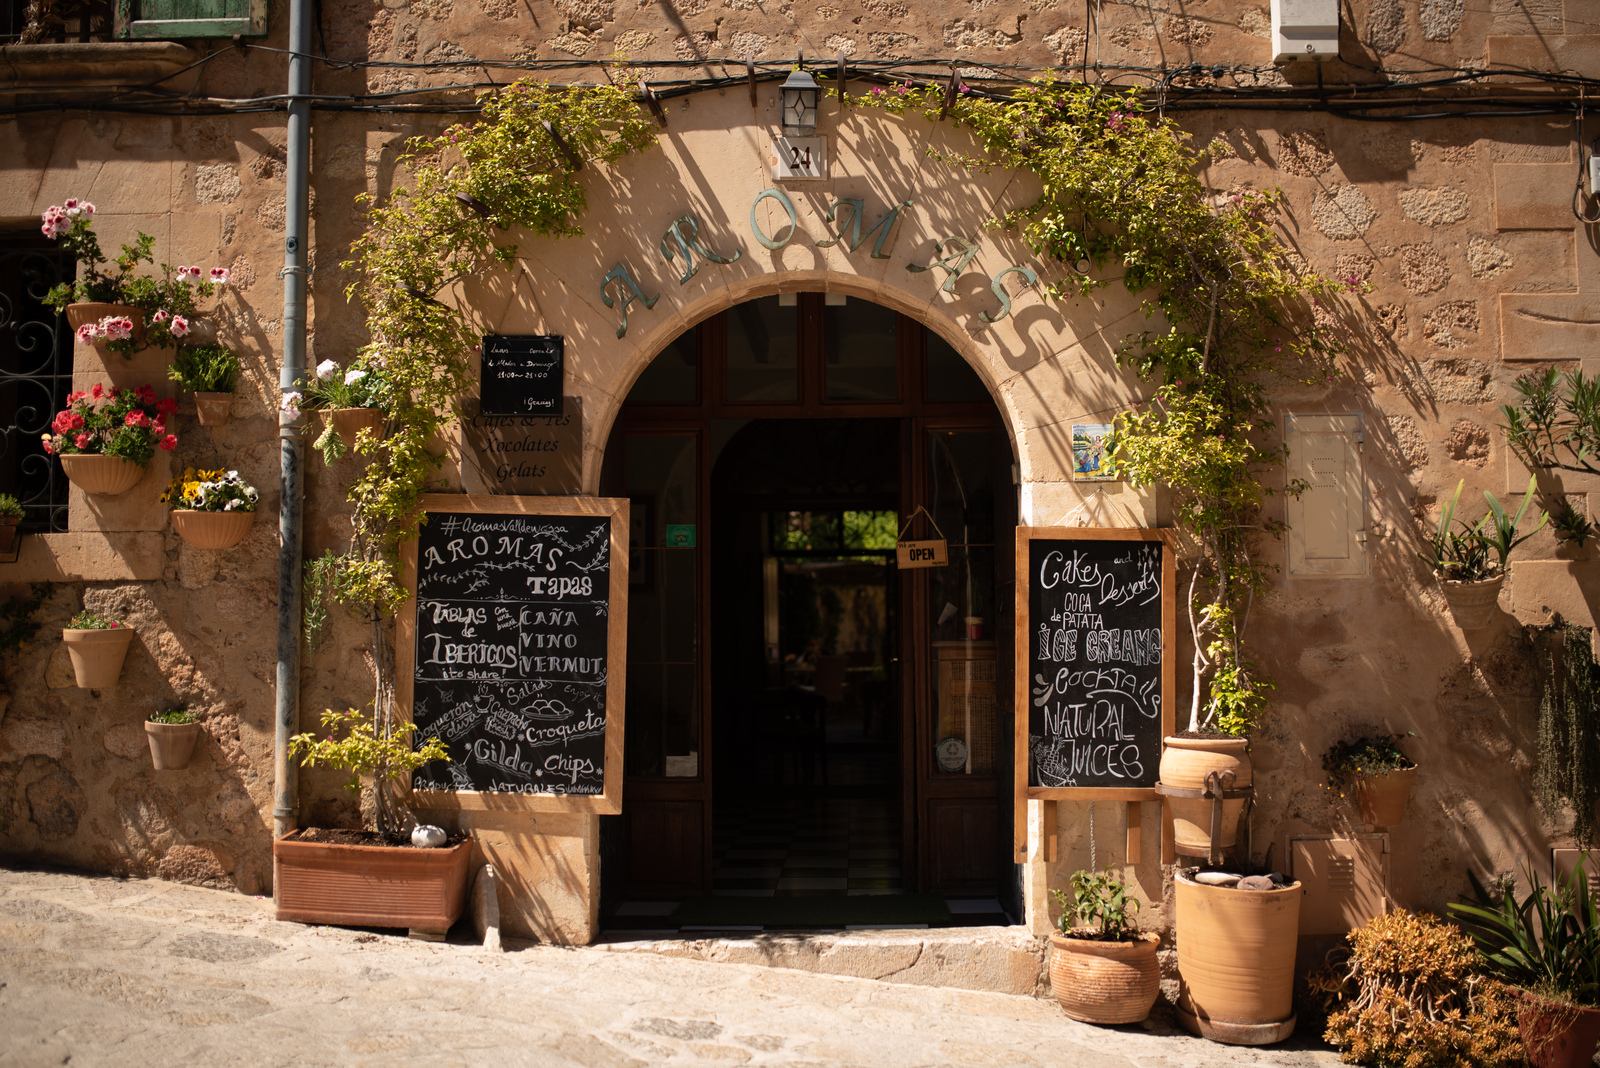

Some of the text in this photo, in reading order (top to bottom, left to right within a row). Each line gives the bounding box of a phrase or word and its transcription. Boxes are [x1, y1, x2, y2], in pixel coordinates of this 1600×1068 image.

[789, 146, 811, 170] 24
[600, 188, 1037, 339] AROMAS
[481, 434, 560, 453] Xocolates
[496, 461, 547, 483] Gelats
[424, 536, 563, 571] AROMAS
[909, 548, 936, 562] OPEN
[1040, 549, 1133, 590] Cakes and
[526, 576, 593, 600] Tapas
[1098, 562, 1161, 607] Desserts
[1064, 592, 1092, 613] COCA
[460, 620, 478, 638] de
[521, 608, 580, 626] CAÑA
[1050, 608, 1104, 631] de PATATA
[520, 632, 578, 649] VINO
[1085, 627, 1162, 666] CREAMS
[520, 656, 603, 674] VERMUT
[507, 676, 553, 706] Salads
[1044, 699, 1136, 741] NATURAL
[474, 739, 534, 775] Gilda
[544, 752, 595, 785] Chips
[489, 778, 566, 794] NATURALES
